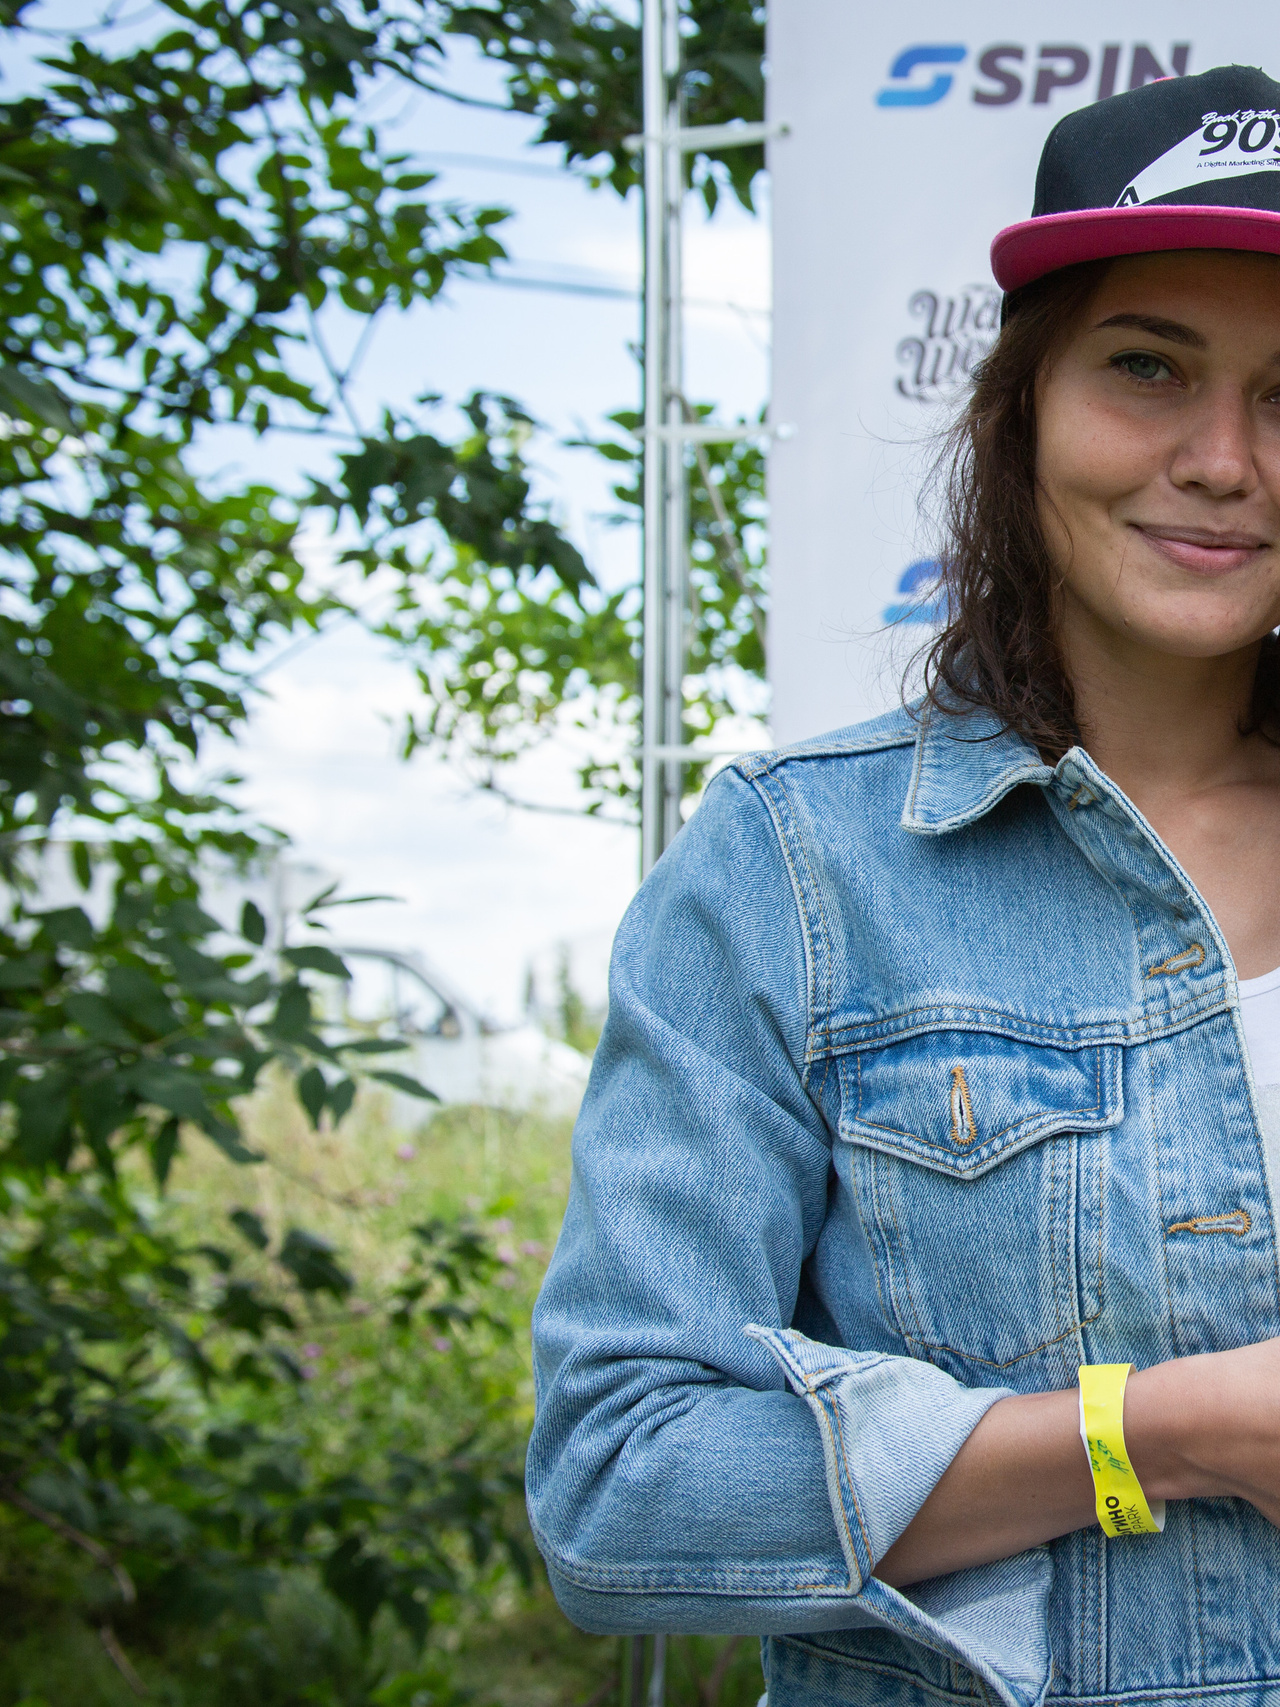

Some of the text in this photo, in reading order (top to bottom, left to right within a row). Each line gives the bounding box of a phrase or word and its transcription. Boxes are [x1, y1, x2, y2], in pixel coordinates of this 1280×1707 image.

[972, 42, 1191, 105] SPIN
[1201, 109, 1240, 125] Back
[1203, 160, 1227, 168] Digital
[1228, 159, 1265, 167] Marketing
